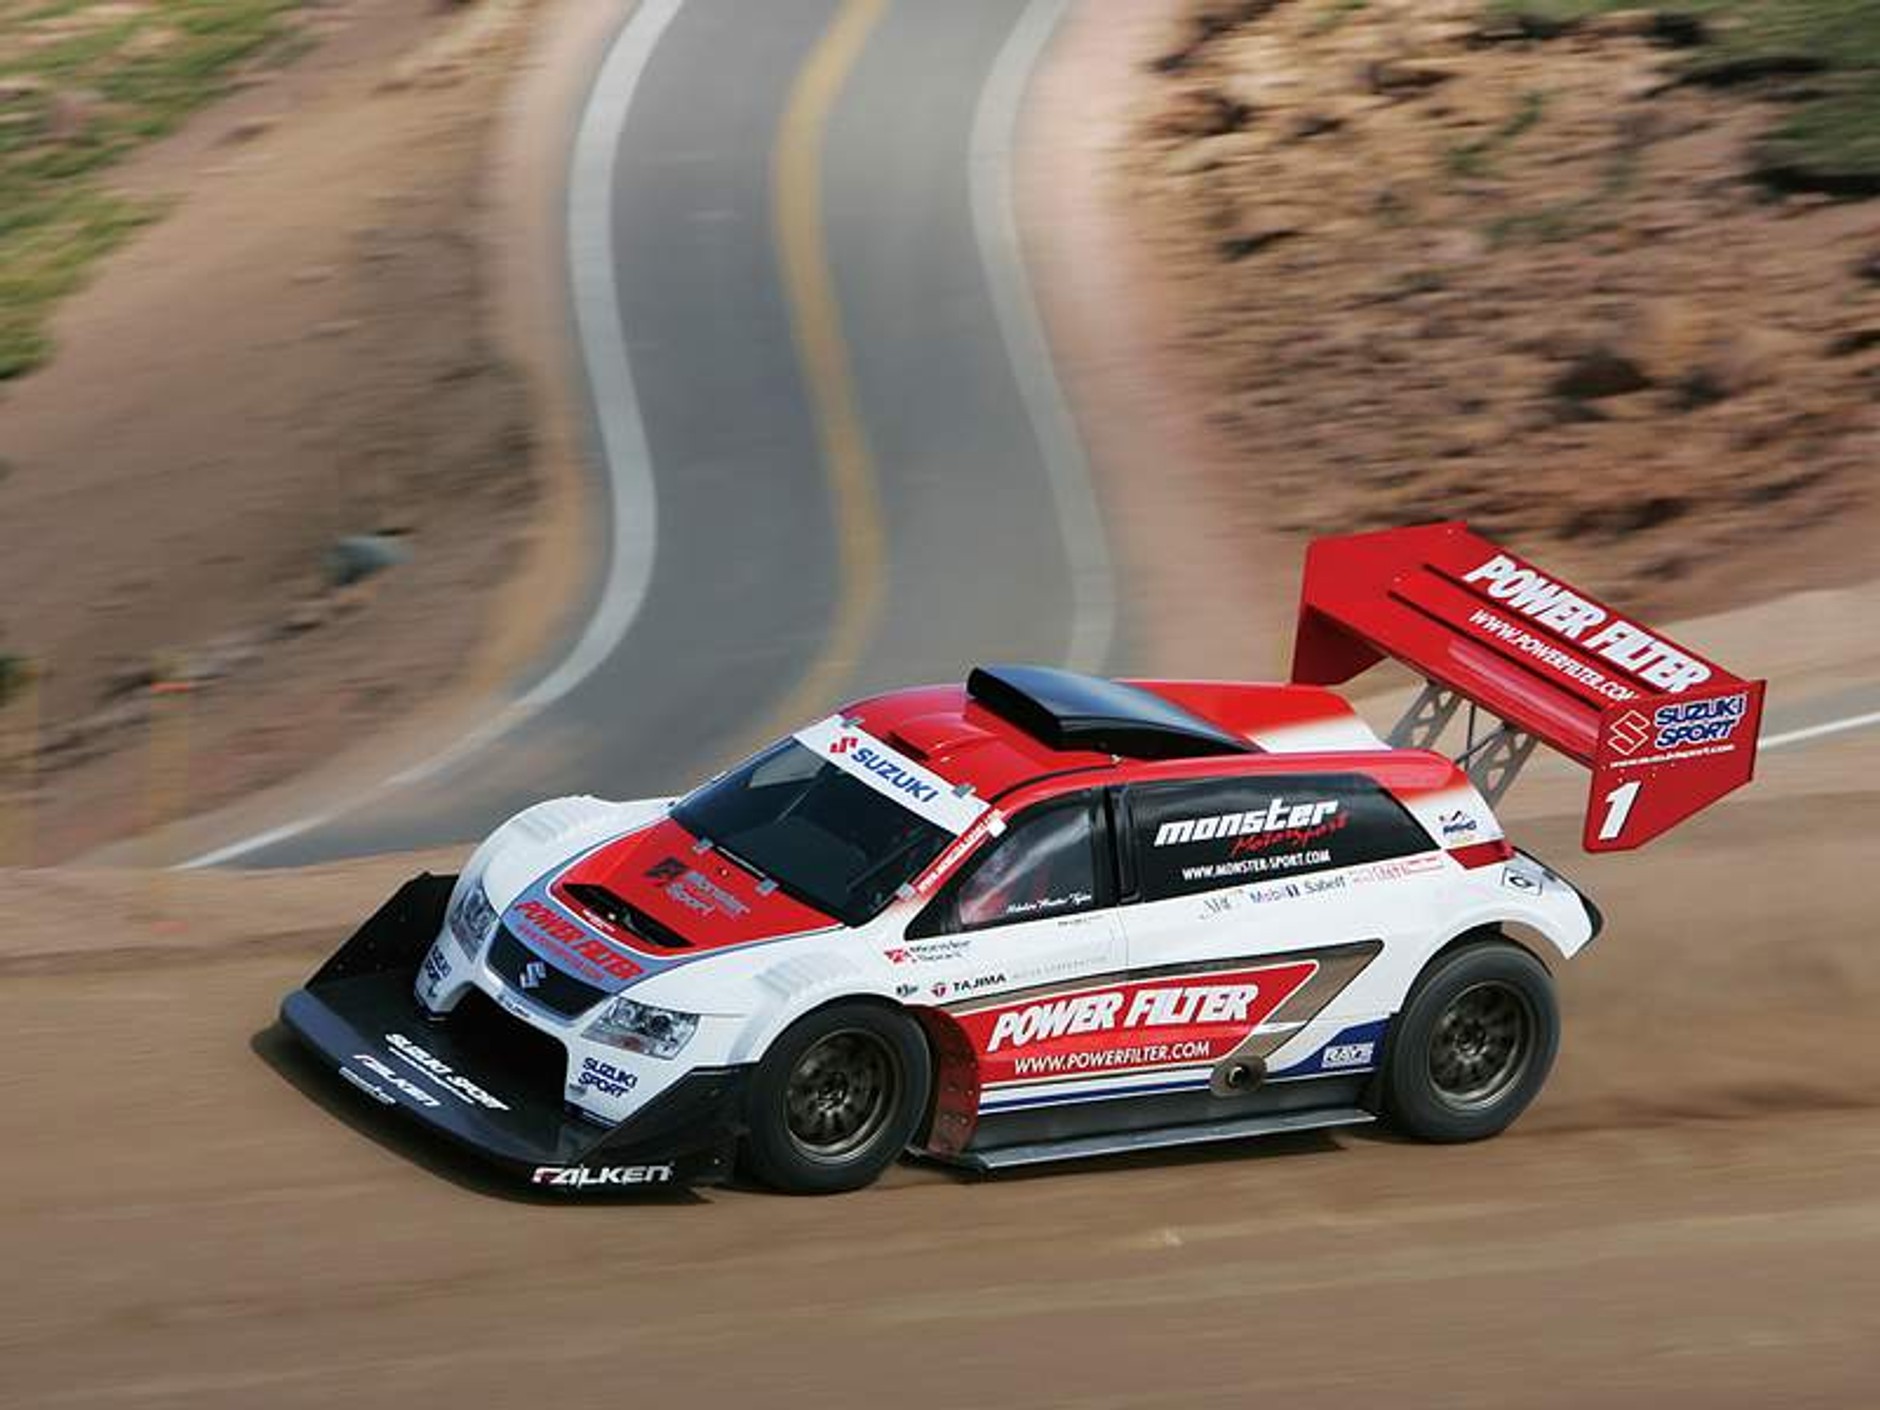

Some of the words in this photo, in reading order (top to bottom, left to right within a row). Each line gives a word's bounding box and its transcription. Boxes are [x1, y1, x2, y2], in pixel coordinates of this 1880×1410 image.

[1463, 555, 1607, 638] POWER
[1585, 620, 1712, 693] FILTER
[1655, 694, 1746, 727] SUZUKI
[1655, 718, 1738, 748] SPORT
[851, 747, 939, 803] SUZUKI
[1154, 799, 1339, 847] monster
[1599, 780, 1642, 840] 1
[952, 973, 1007, 992] TAJIMA
[987, 992, 1125, 1052] POWER
[1123, 984, 1259, 1028] FILTER
[582, 1057, 638, 1088] SUZUKI
[1014, 1042, 1210, 1074] WWW.POWERFILTER.COM
[578, 1071, 629, 1098] SPORT
[531, 1163, 671, 1188] FALKEN
